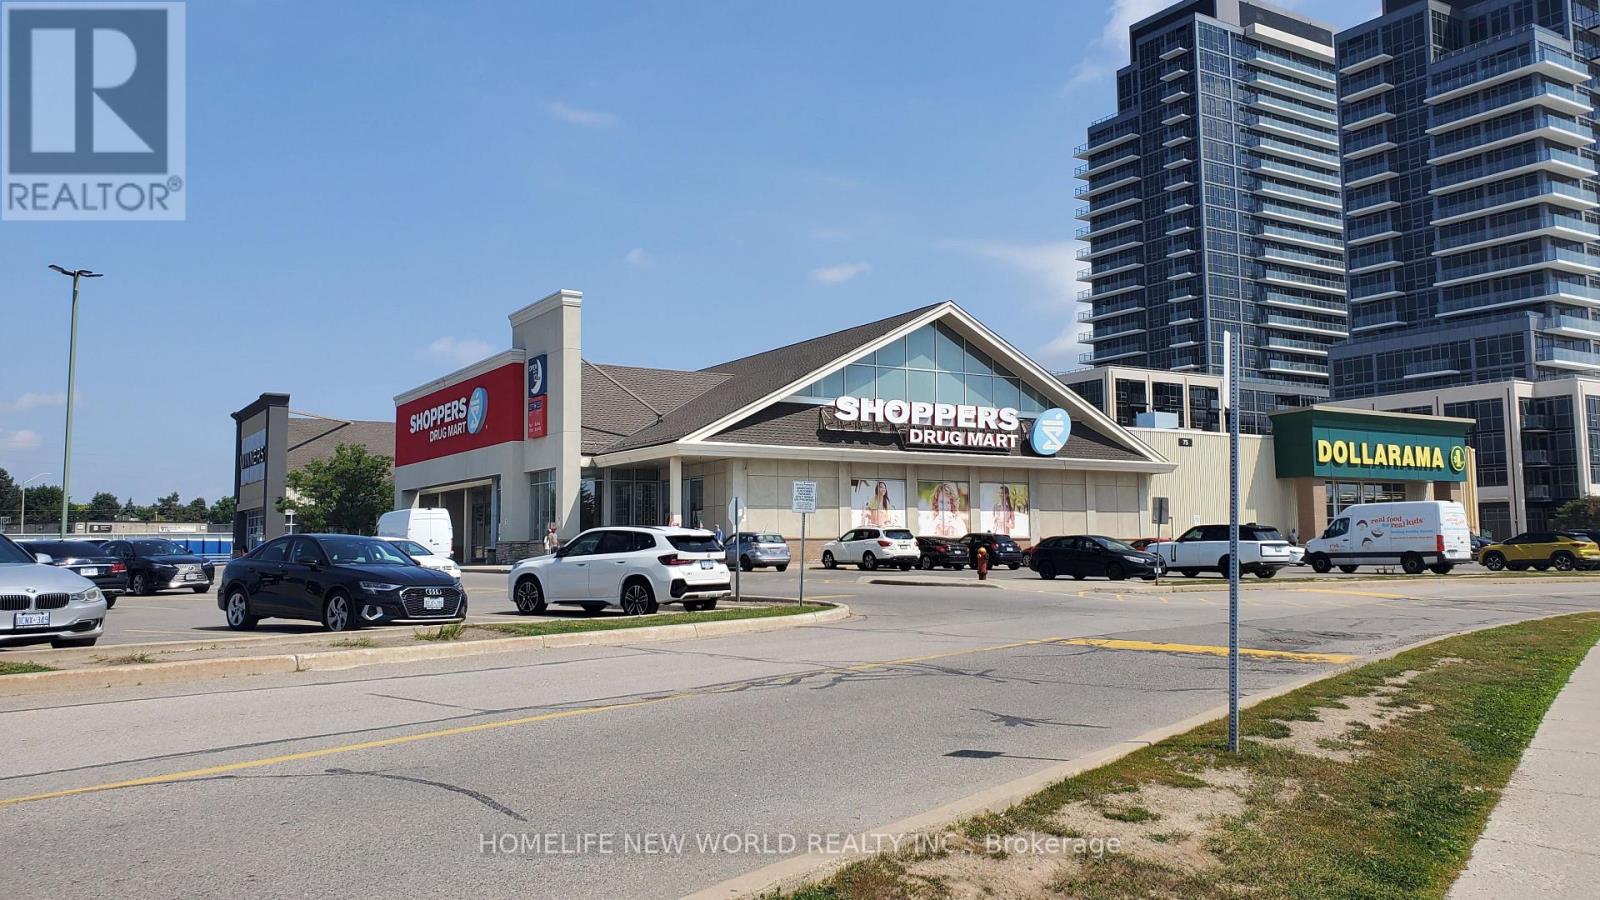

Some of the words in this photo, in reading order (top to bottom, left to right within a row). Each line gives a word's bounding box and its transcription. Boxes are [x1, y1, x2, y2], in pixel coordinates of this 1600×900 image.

[410, 397, 467, 434] SHOPPERS
[834, 396, 1020, 430] SHOPPERS
[430, 427, 447, 442] DRUG
[447, 421, 467, 437] MART
[909, 428, 963, 445] DRUG
[966, 431, 1018, 448] MART
[1317, 439, 1445, 468] DOLLARAMA
